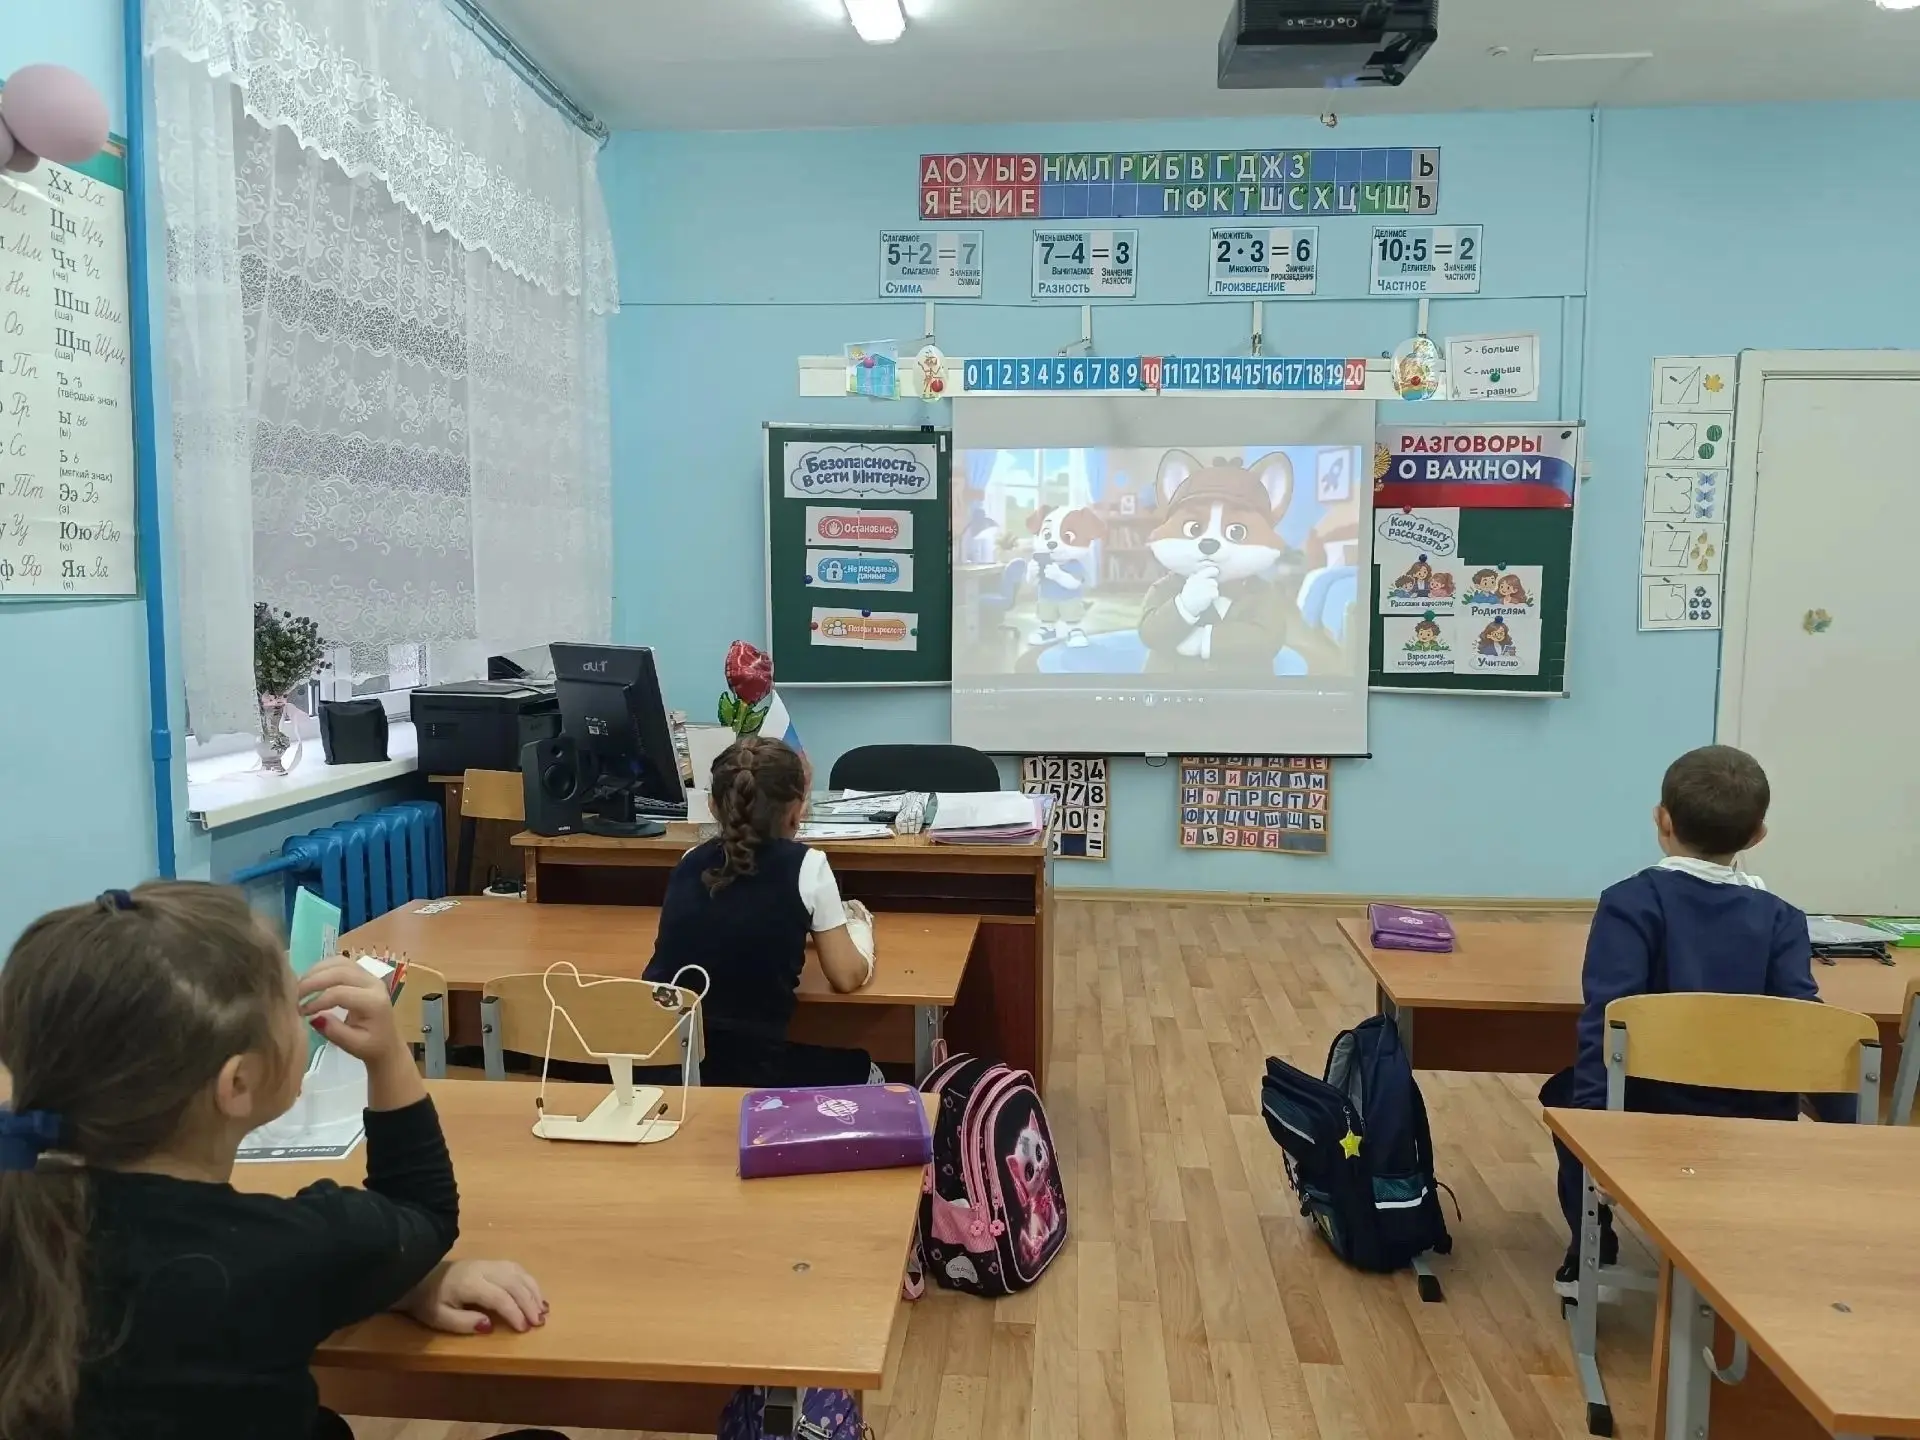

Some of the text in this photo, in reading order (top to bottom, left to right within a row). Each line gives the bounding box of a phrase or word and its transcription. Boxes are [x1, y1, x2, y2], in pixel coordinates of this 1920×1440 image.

[51, 208, 77, 237] Цц
[52, 248, 77, 273] Чч
[54, 288, 89, 314] Шш
[56, 327, 92, 355] Щщ
[1481, 344, 1519, 354] больше
[1481, 366, 1521, 375] меньше
[1487, 388, 1517, 397] равно
[1401, 435, 1542, 453] РАЗГОВОРЫ
[806, 456, 916, 473] Безопасность
[1399, 459, 1541, 480] О ВАЖНОМ
[802, 470, 925, 487] в сети Интернет
[60, 483, 78, 502] Ээ
[60, 522, 92, 540] Юю
[844, 523, 894, 534] Остановись
[1391, 517, 1415, 531] Кому
[1426, 527, 1451, 543] могу
[1389, 528, 1449, 552] рассказать?
[62, 559, 86, 579] Яя
[1471, 607, 1526, 616] Родителям
[1478, 658, 1518, 668] Учителю
[1049, 762, 1060, 779] 2
[1070, 762, 1082, 779] 3
[1090, 762, 1103, 779] 4
[1071, 783, 1084, 801] 7
[1091, 786, 1103, 803] 8
